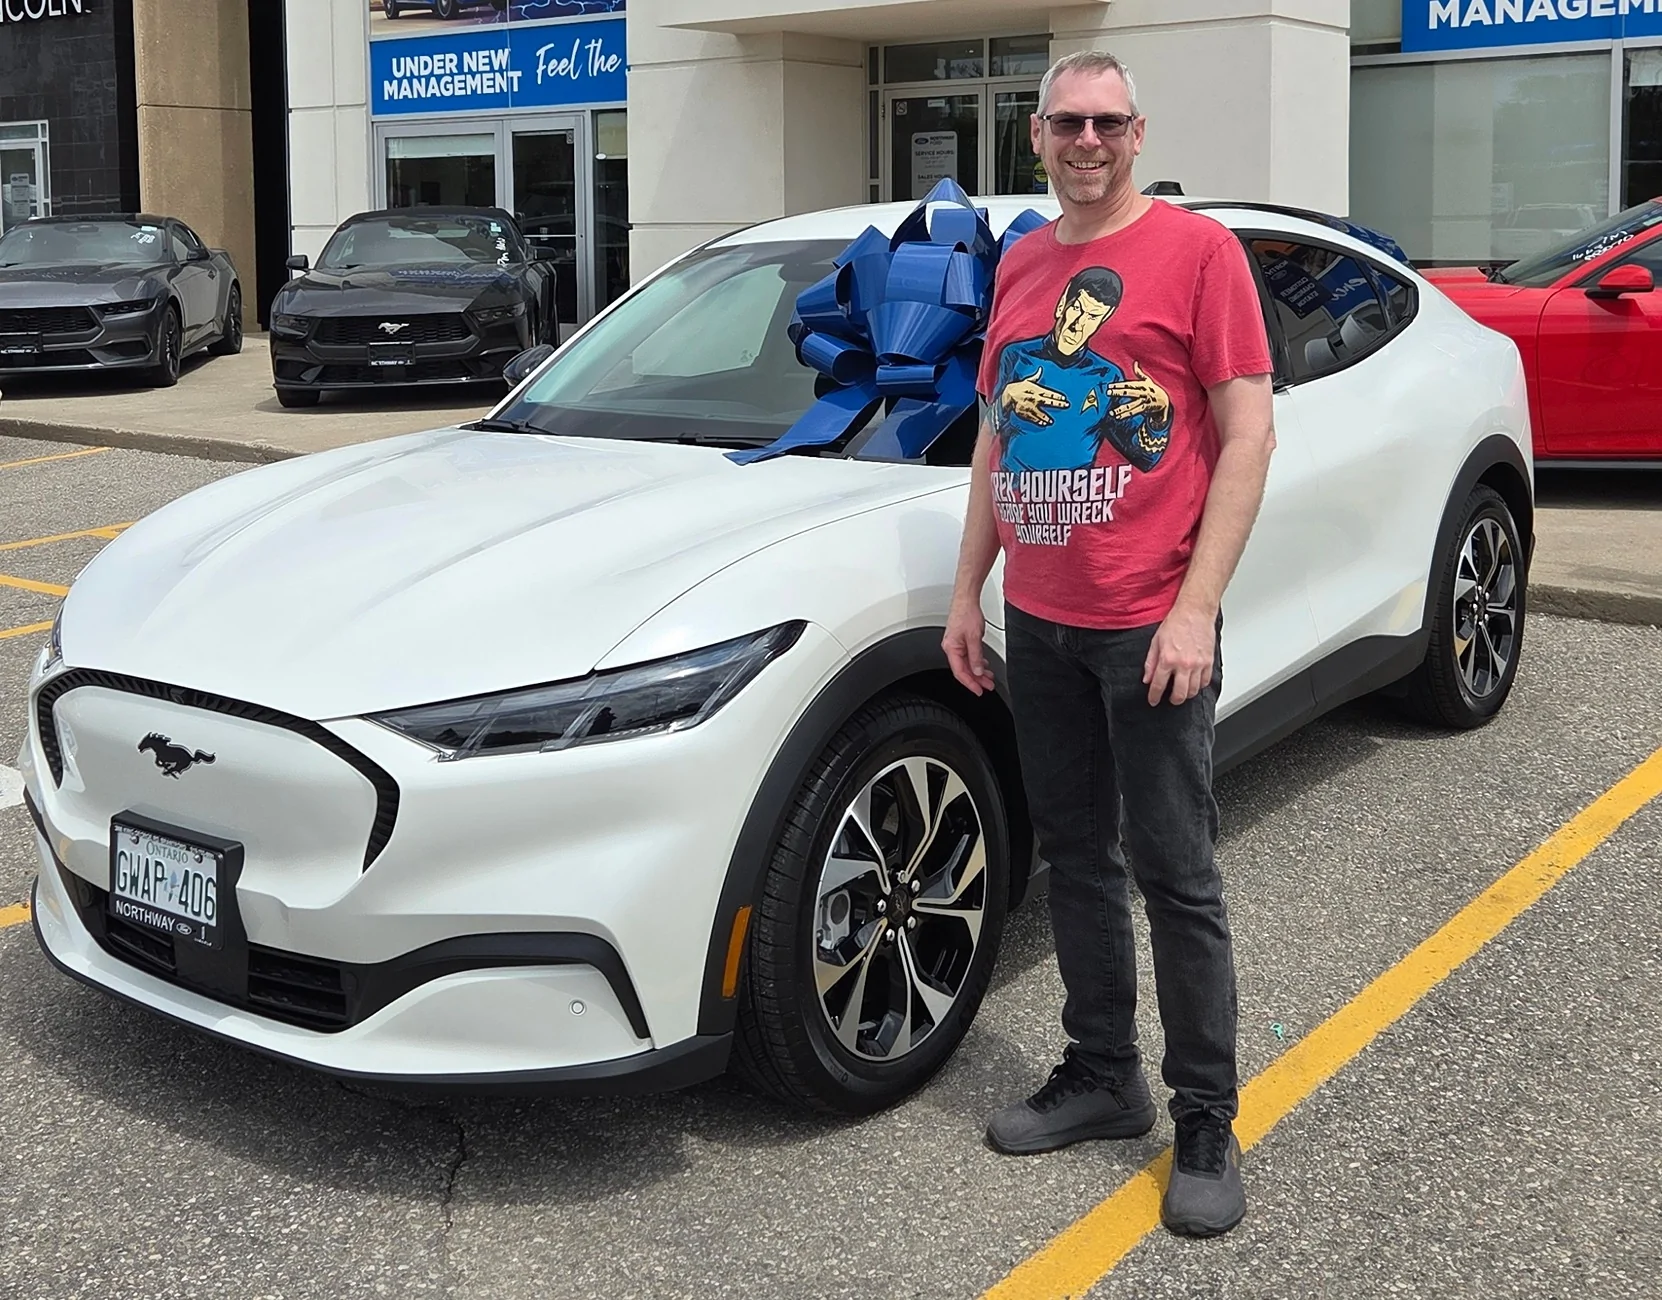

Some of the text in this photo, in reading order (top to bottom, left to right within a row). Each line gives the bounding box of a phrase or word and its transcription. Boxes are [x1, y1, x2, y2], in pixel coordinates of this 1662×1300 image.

[1428, 0, 1662, 29] MANAGEM
[392, 48, 511, 78] UNDER NEW
[536, 38, 622, 85] Feel the
[383, 70, 522, 100] MANAGEMENT
[1020, 463, 1132, 503] YOURSELF
[1027, 503, 1053, 524] YOU
[1057, 500, 1114, 524] WRECK
[1014, 524, 1072, 546] YOURSELF
[117, 850, 217, 920] GWAP 406
[116, 900, 176, 932] NORTHWAY
